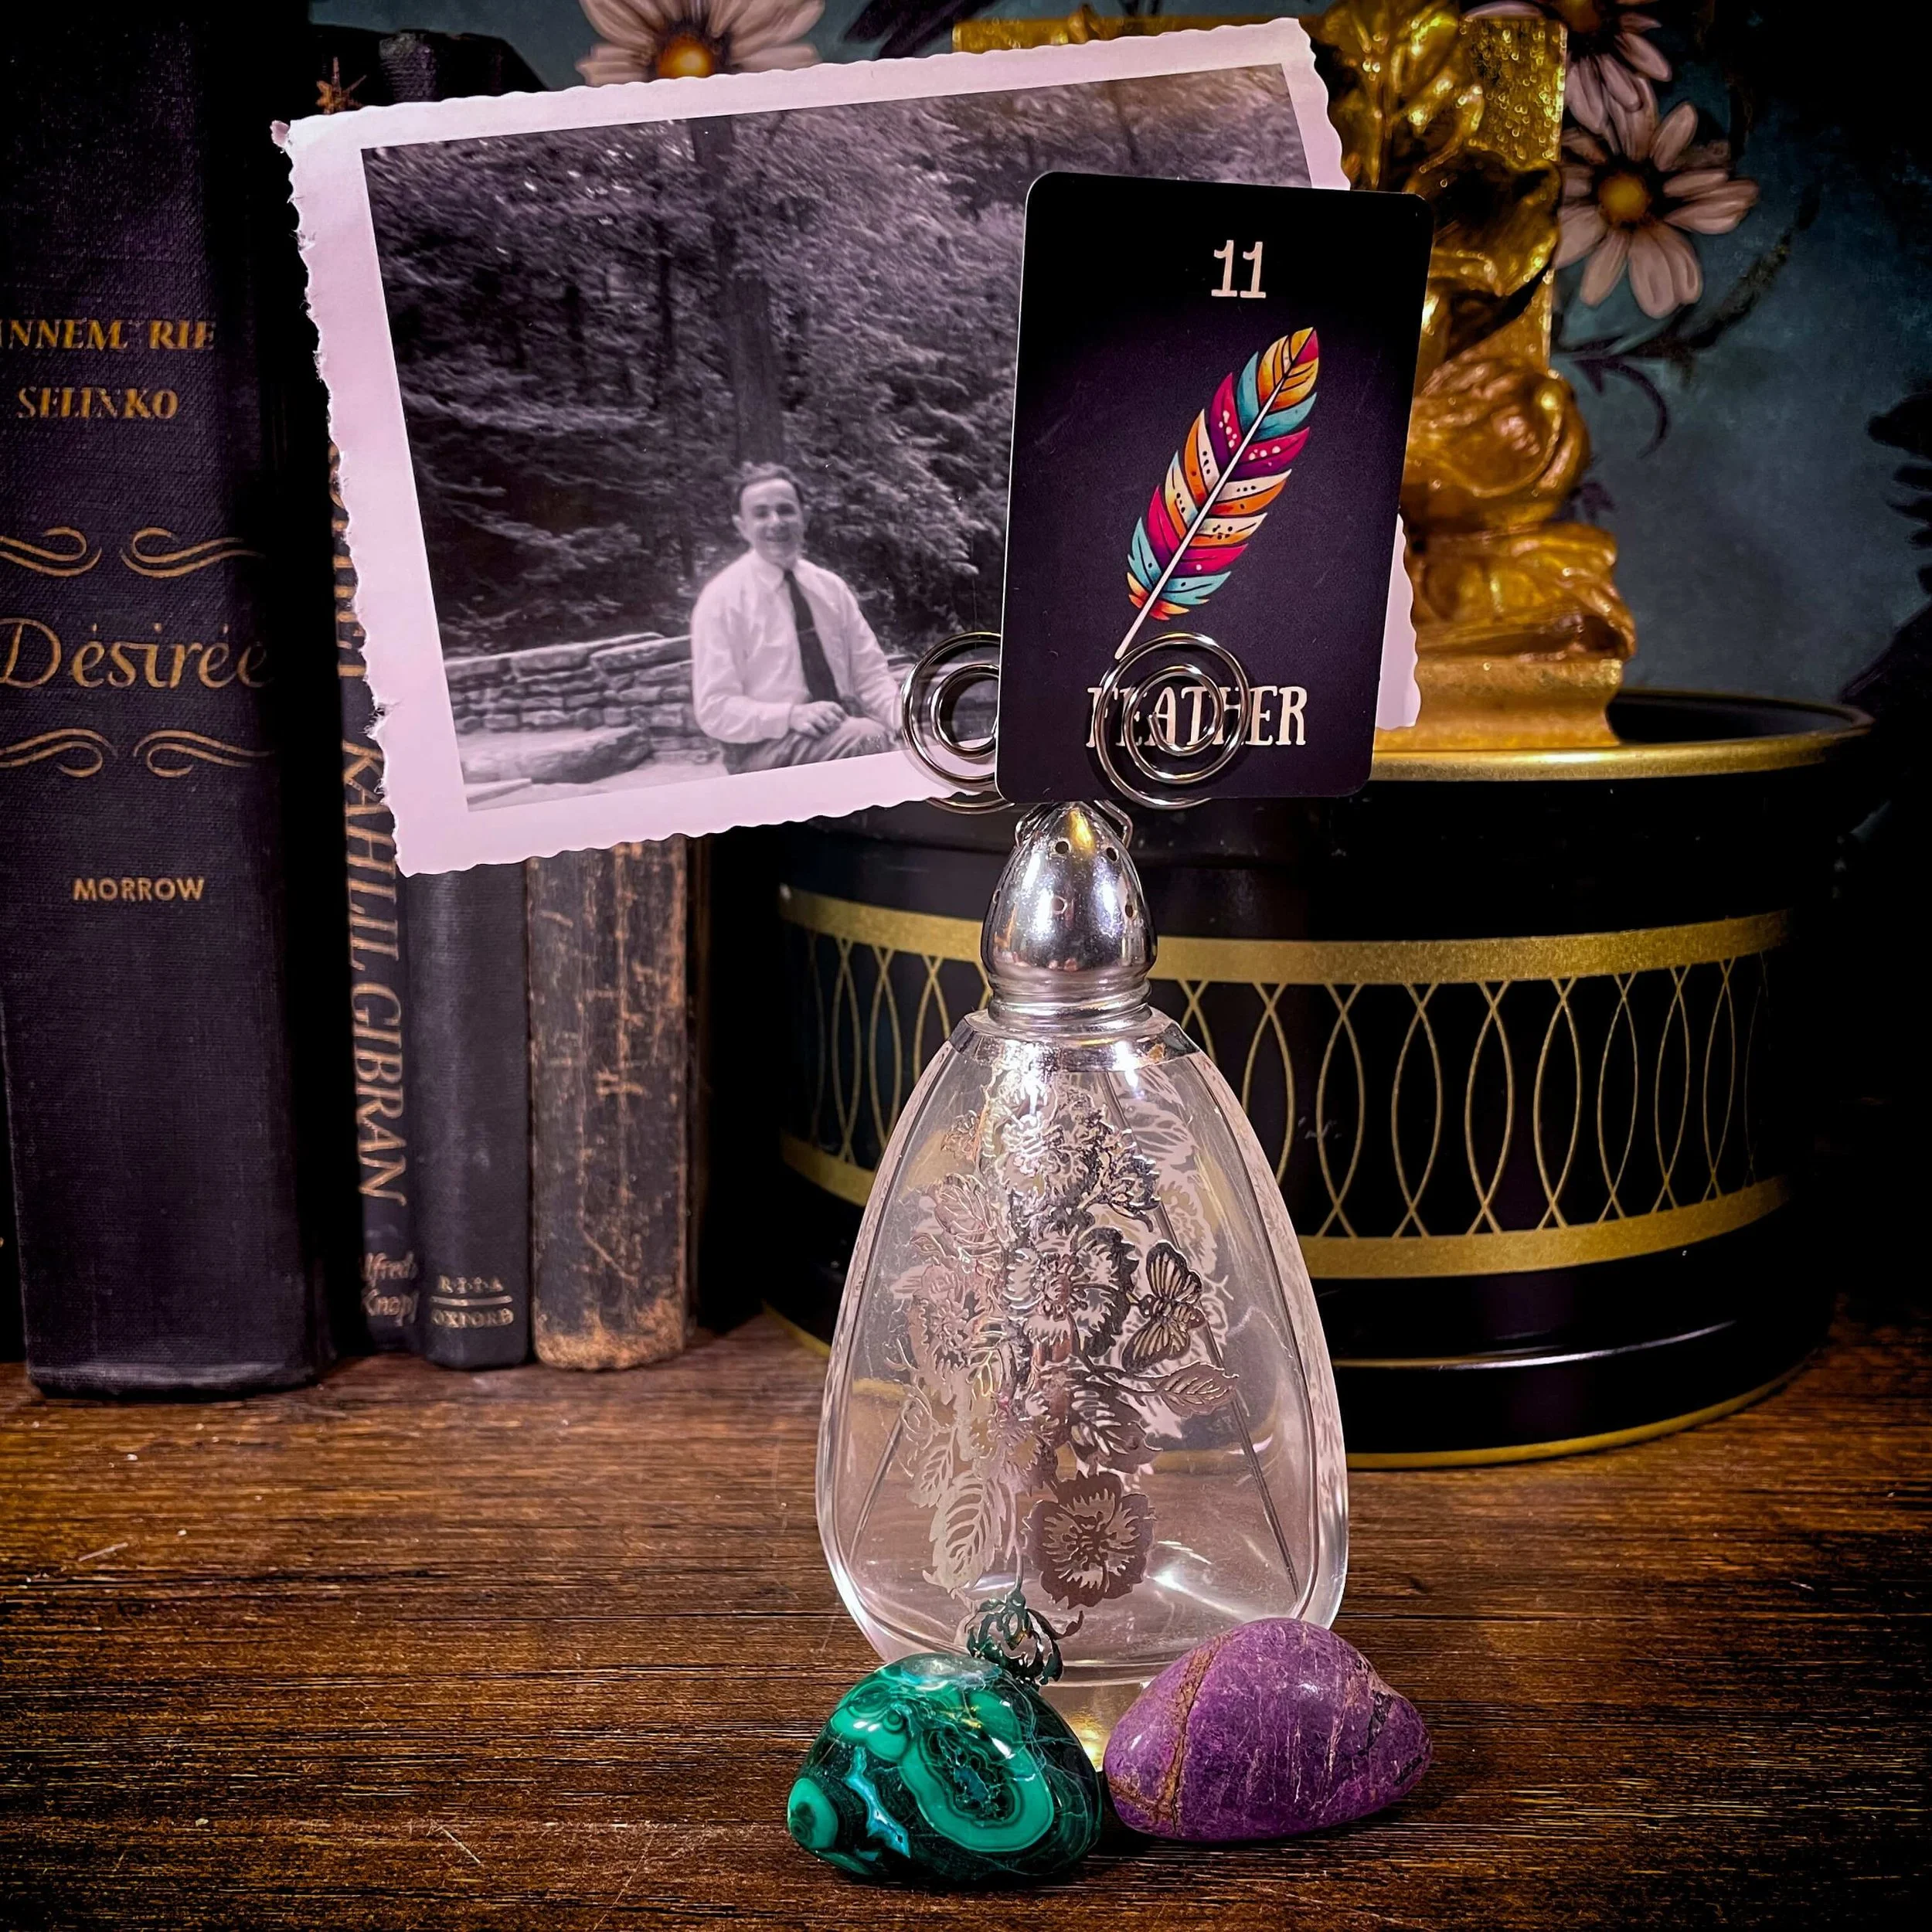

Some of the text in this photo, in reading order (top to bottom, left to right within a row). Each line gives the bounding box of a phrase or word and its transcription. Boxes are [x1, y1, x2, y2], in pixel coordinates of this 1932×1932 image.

[1211, 239, 1267, 299] 11
[0, 318, 217, 351] NNEMRIE
[342, 739, 399, 971] KAHLIL
[73, 876, 205, 903] MORROW
[351, 981, 407, 1207] GIBRAN
[430, 1308, 515, 1329] OXFORD
